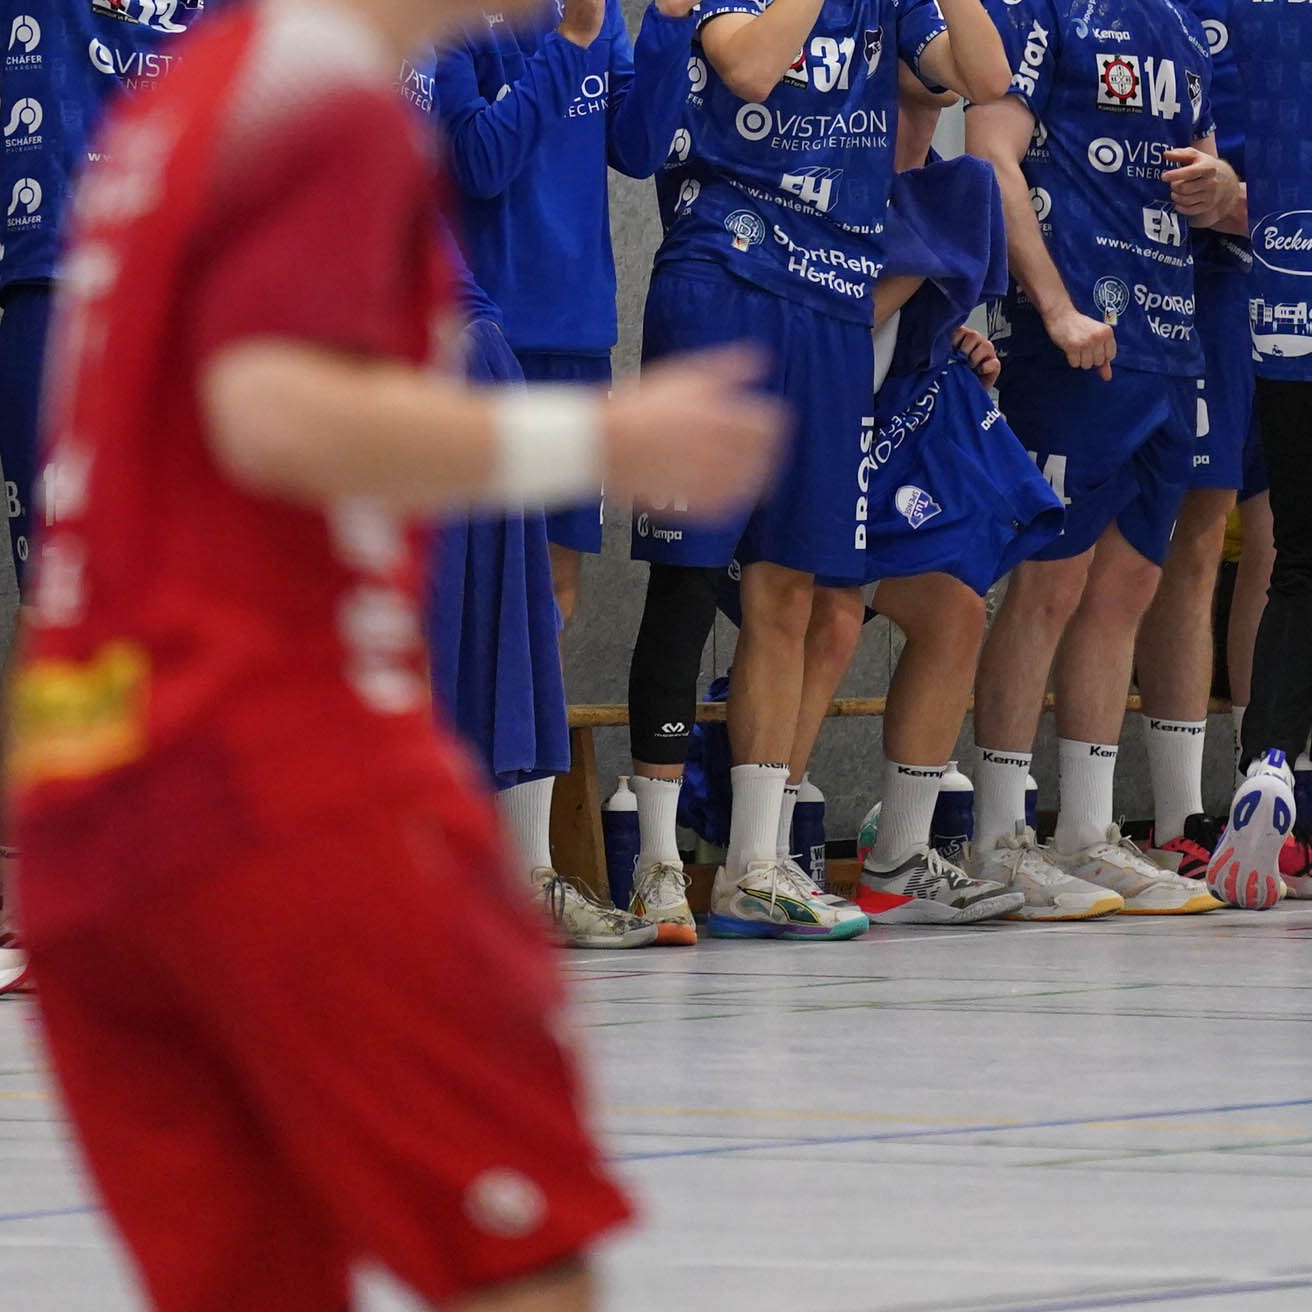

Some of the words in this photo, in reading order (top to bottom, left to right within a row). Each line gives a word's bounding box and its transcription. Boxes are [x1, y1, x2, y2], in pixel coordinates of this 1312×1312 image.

[1092, 28, 1131, 42] Kempa
[810, 37, 855, 92] 31
[1144, 55, 1181, 120] 14
[5, 136, 43, 147] SCHÄFER
[7, 215, 42, 227] SCHÄFER
